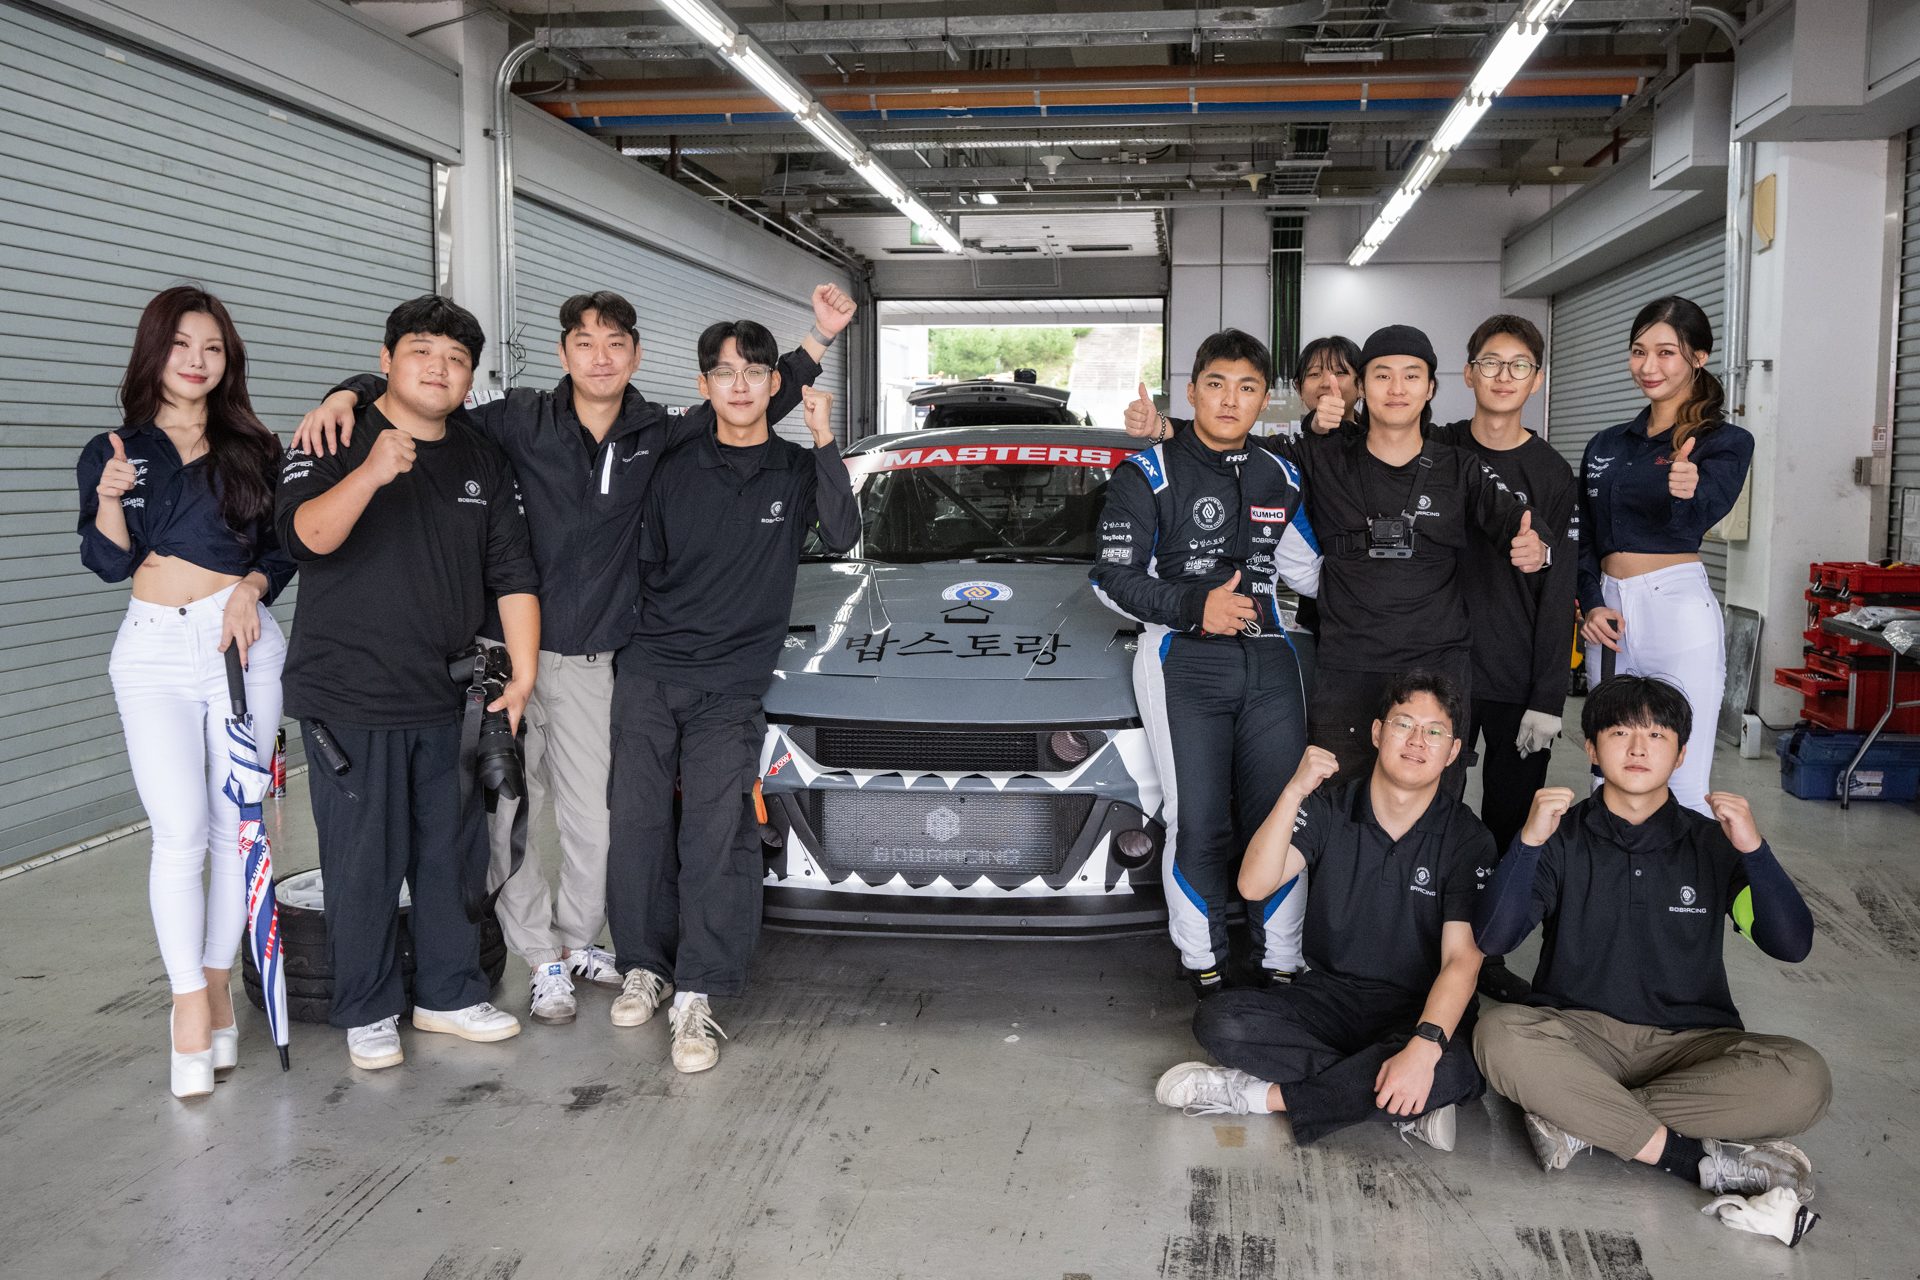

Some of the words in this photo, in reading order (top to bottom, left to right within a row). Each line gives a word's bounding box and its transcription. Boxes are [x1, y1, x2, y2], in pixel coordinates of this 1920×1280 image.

[883, 446, 1112, 468] MASTERS
[457, 497, 488, 506] BOBRACG
[1252, 510, 1284, 519] KUMHO
[845, 628, 1072, 666] 밥스토랑
[774, 753, 790, 770] TOW
[873, 846, 1021, 865] BOBRACING
[1668, 906, 1707, 914] BOBRACING
